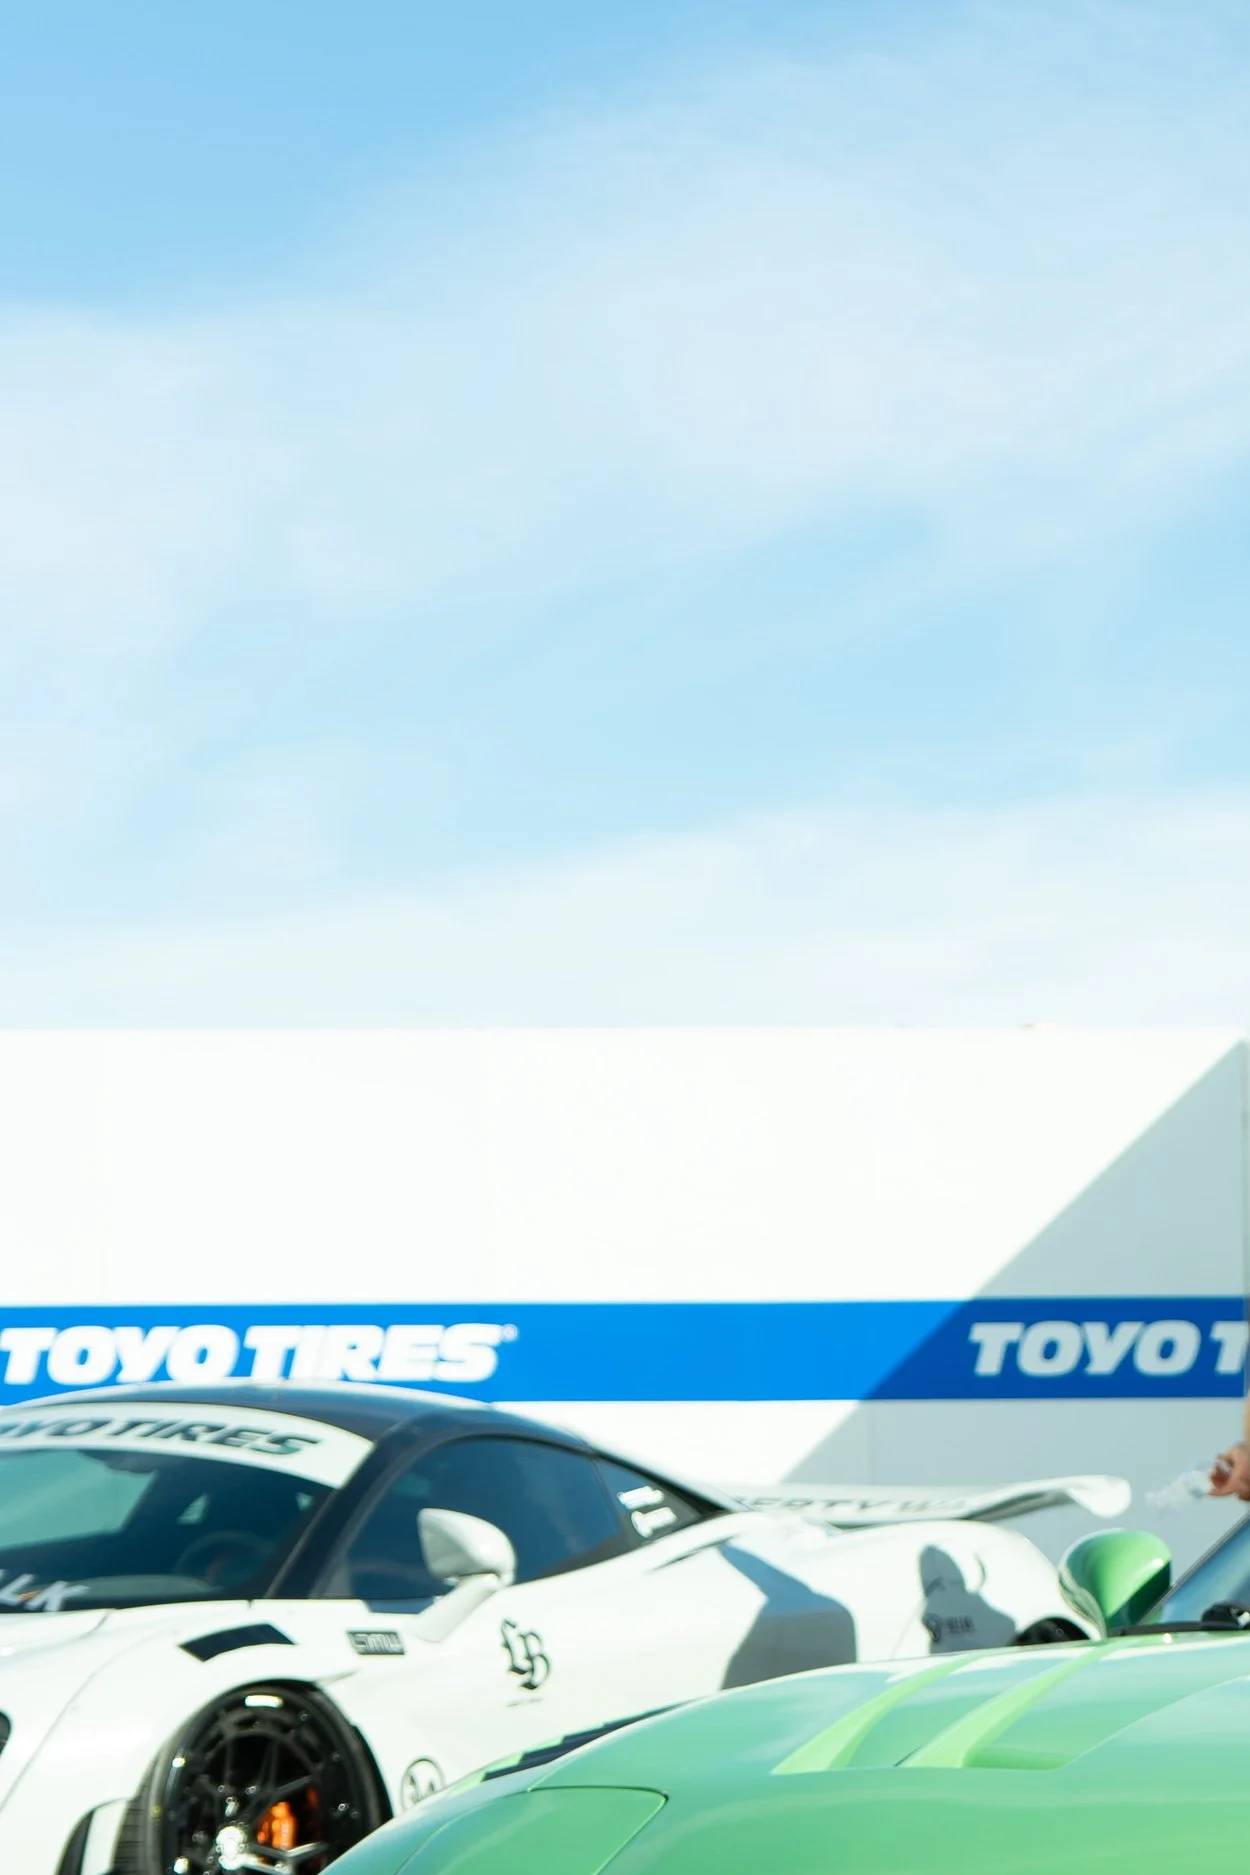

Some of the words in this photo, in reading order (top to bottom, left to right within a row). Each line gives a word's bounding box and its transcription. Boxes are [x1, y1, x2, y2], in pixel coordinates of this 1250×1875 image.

[2, 1324, 240, 1385] TOYO
[243, 1324, 502, 1384] TIRES
[967, 1319, 1202, 1377] TOYO
[0, 1417, 114, 1438] YO
[109, 1416, 322, 1456] TIRES
